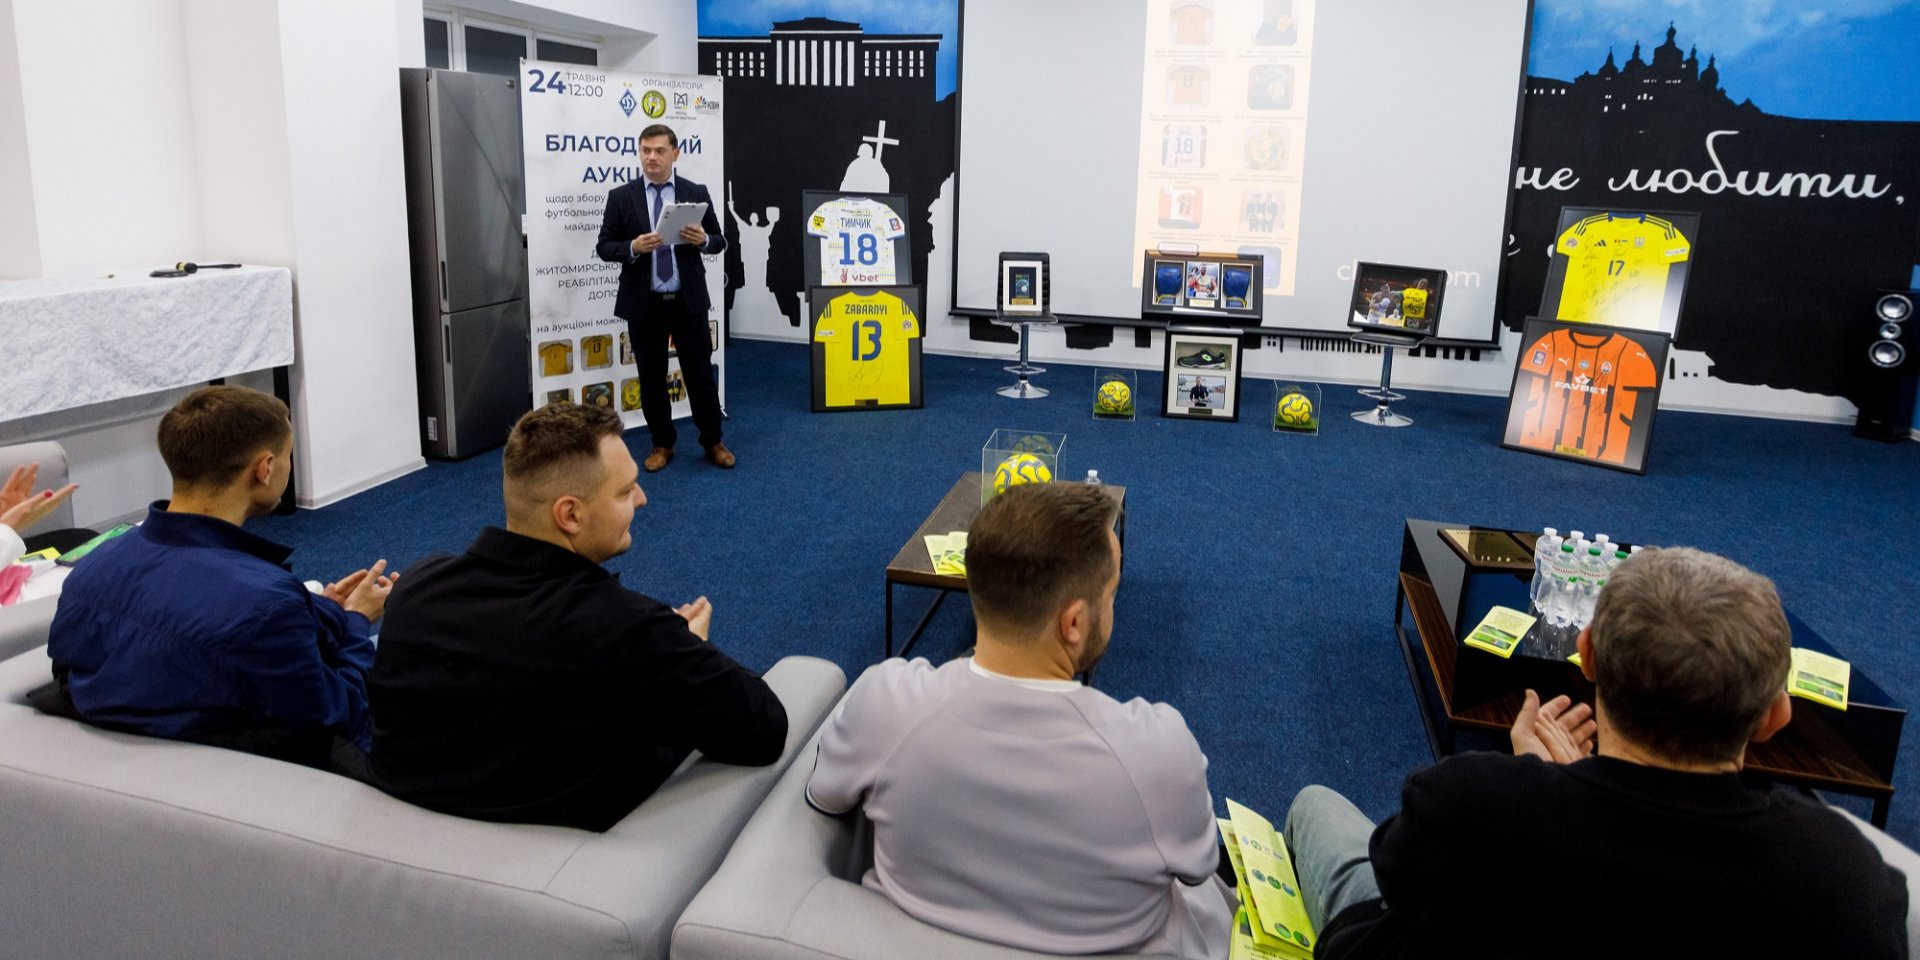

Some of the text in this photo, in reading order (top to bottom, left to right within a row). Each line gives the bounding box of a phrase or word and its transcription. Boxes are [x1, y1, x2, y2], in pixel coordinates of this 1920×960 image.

[528, 69, 566, 95] 24
[566, 72, 606, 83] ТРАВНЯ
[568, 84, 604, 98] 12:00
[545, 134, 702, 156] БЛАГОДИЙ
[545, 193, 606, 204] щодо збору
[544, 208, 606, 219] футбольног
[564, 222, 603, 231] майдан
[840, 217, 872, 229] ТИМЧИК
[839, 232, 878, 266] 18
[1607, 260, 1625, 276] 17
[558, 275, 619, 289] РЕАБІЛІТАЦ
[851, 273, 879, 282] vbet
[845, 303, 888, 315] ZABARNYI
[536, 325, 549, 333] на
[552, 318, 593, 333] аукціоні
[851, 320, 882, 361] 13
[1554, 380, 1608, 395] FAVBET
